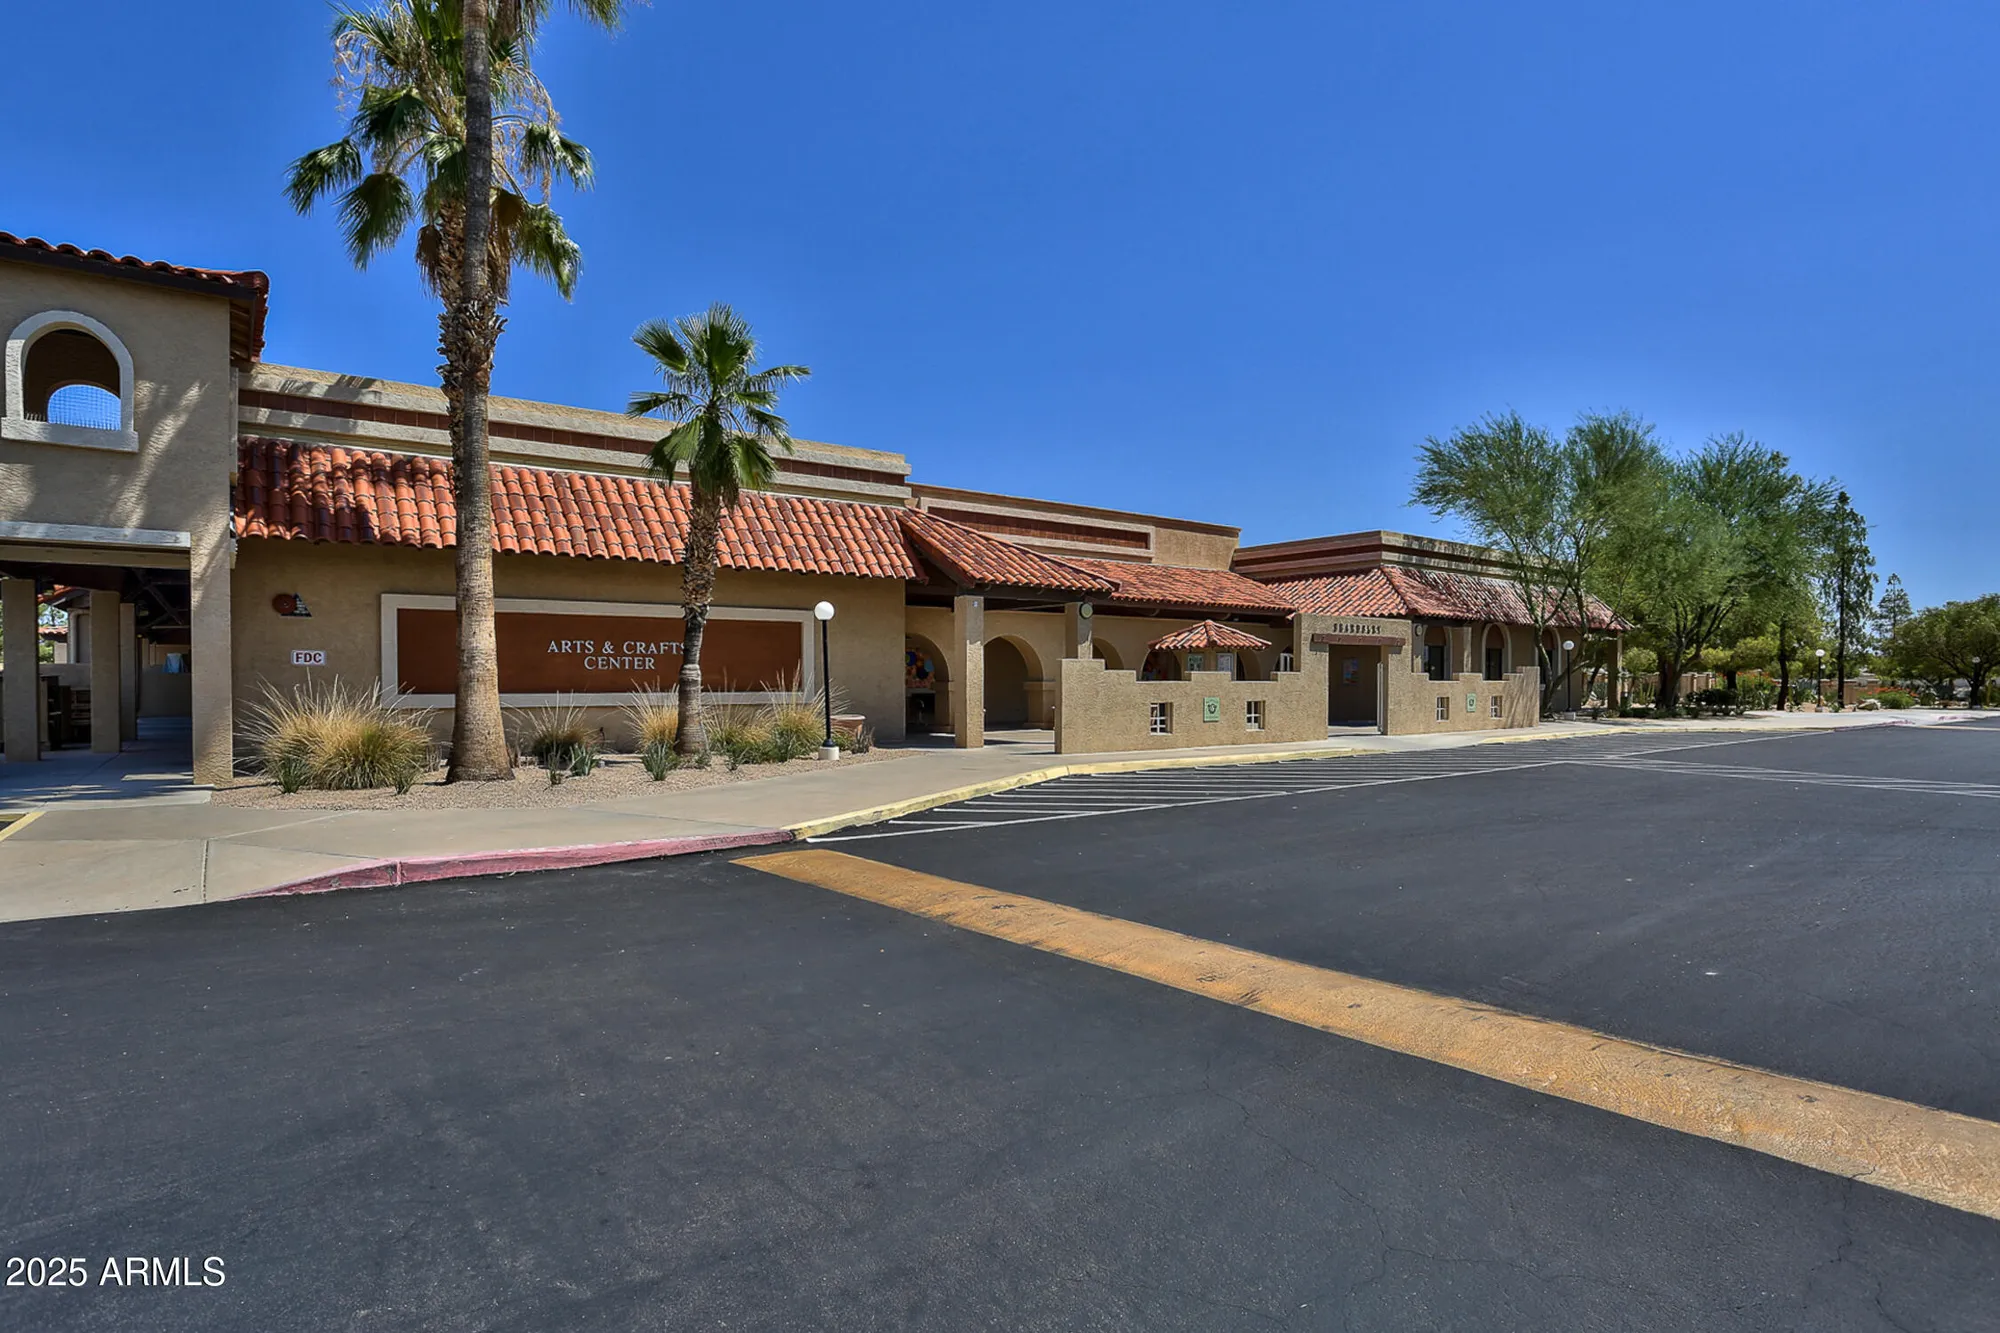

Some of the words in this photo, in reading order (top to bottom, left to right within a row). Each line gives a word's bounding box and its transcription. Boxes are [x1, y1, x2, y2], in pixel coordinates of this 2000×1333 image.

[548, 640, 595, 654] ARTS
[602, 641, 615, 654] &
[295, 652, 322, 663] FDC
[584, 656, 656, 670] CENTER
